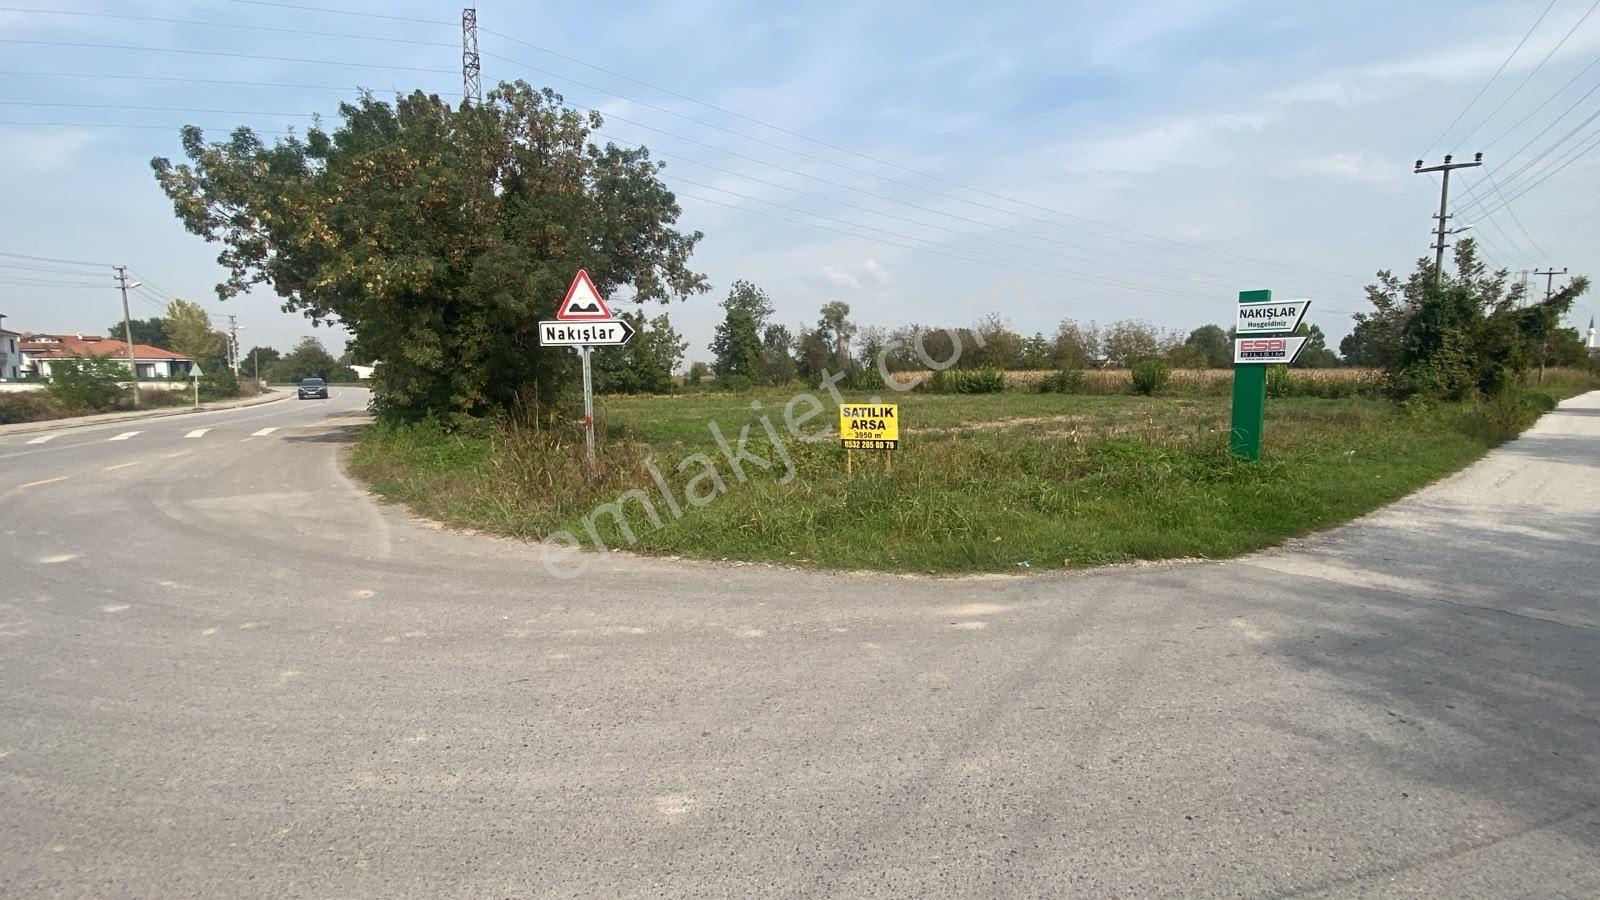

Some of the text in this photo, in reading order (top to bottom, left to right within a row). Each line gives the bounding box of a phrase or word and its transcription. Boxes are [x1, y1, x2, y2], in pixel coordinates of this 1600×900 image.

[1240, 307, 1296, 320] NAKIŞLAR
[1247, 321, 1287, 329] Hoşgeldiniz
[546, 326, 614, 341] Nakışlar
[843, 407, 894, 418] SATILIK
[851, 419, 886, 430] ARSA
[854, 431, 873, 439] 3950
[844, 440, 860, 448] 0532
[885, 441, 895, 449] 79
